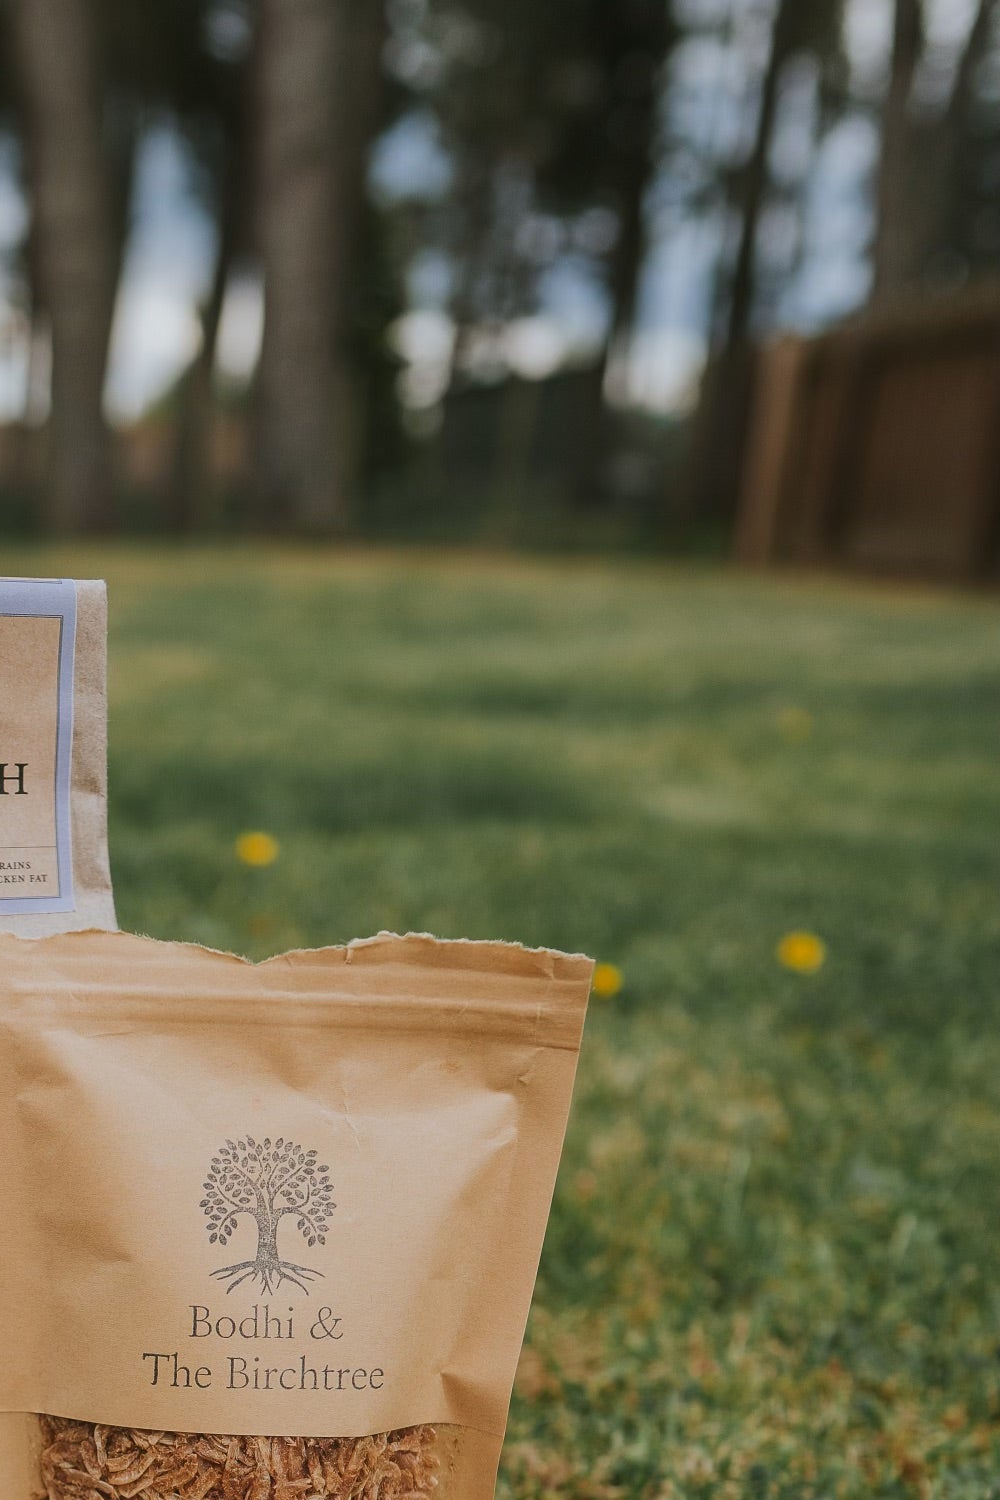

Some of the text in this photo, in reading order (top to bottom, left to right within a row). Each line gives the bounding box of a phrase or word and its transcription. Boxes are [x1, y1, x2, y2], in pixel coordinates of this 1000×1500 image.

[29, 874, 48, 883] FAT
[189, 1303, 344, 1340] Bodhi &
[142, 1352, 385, 1390] The Birchtree
